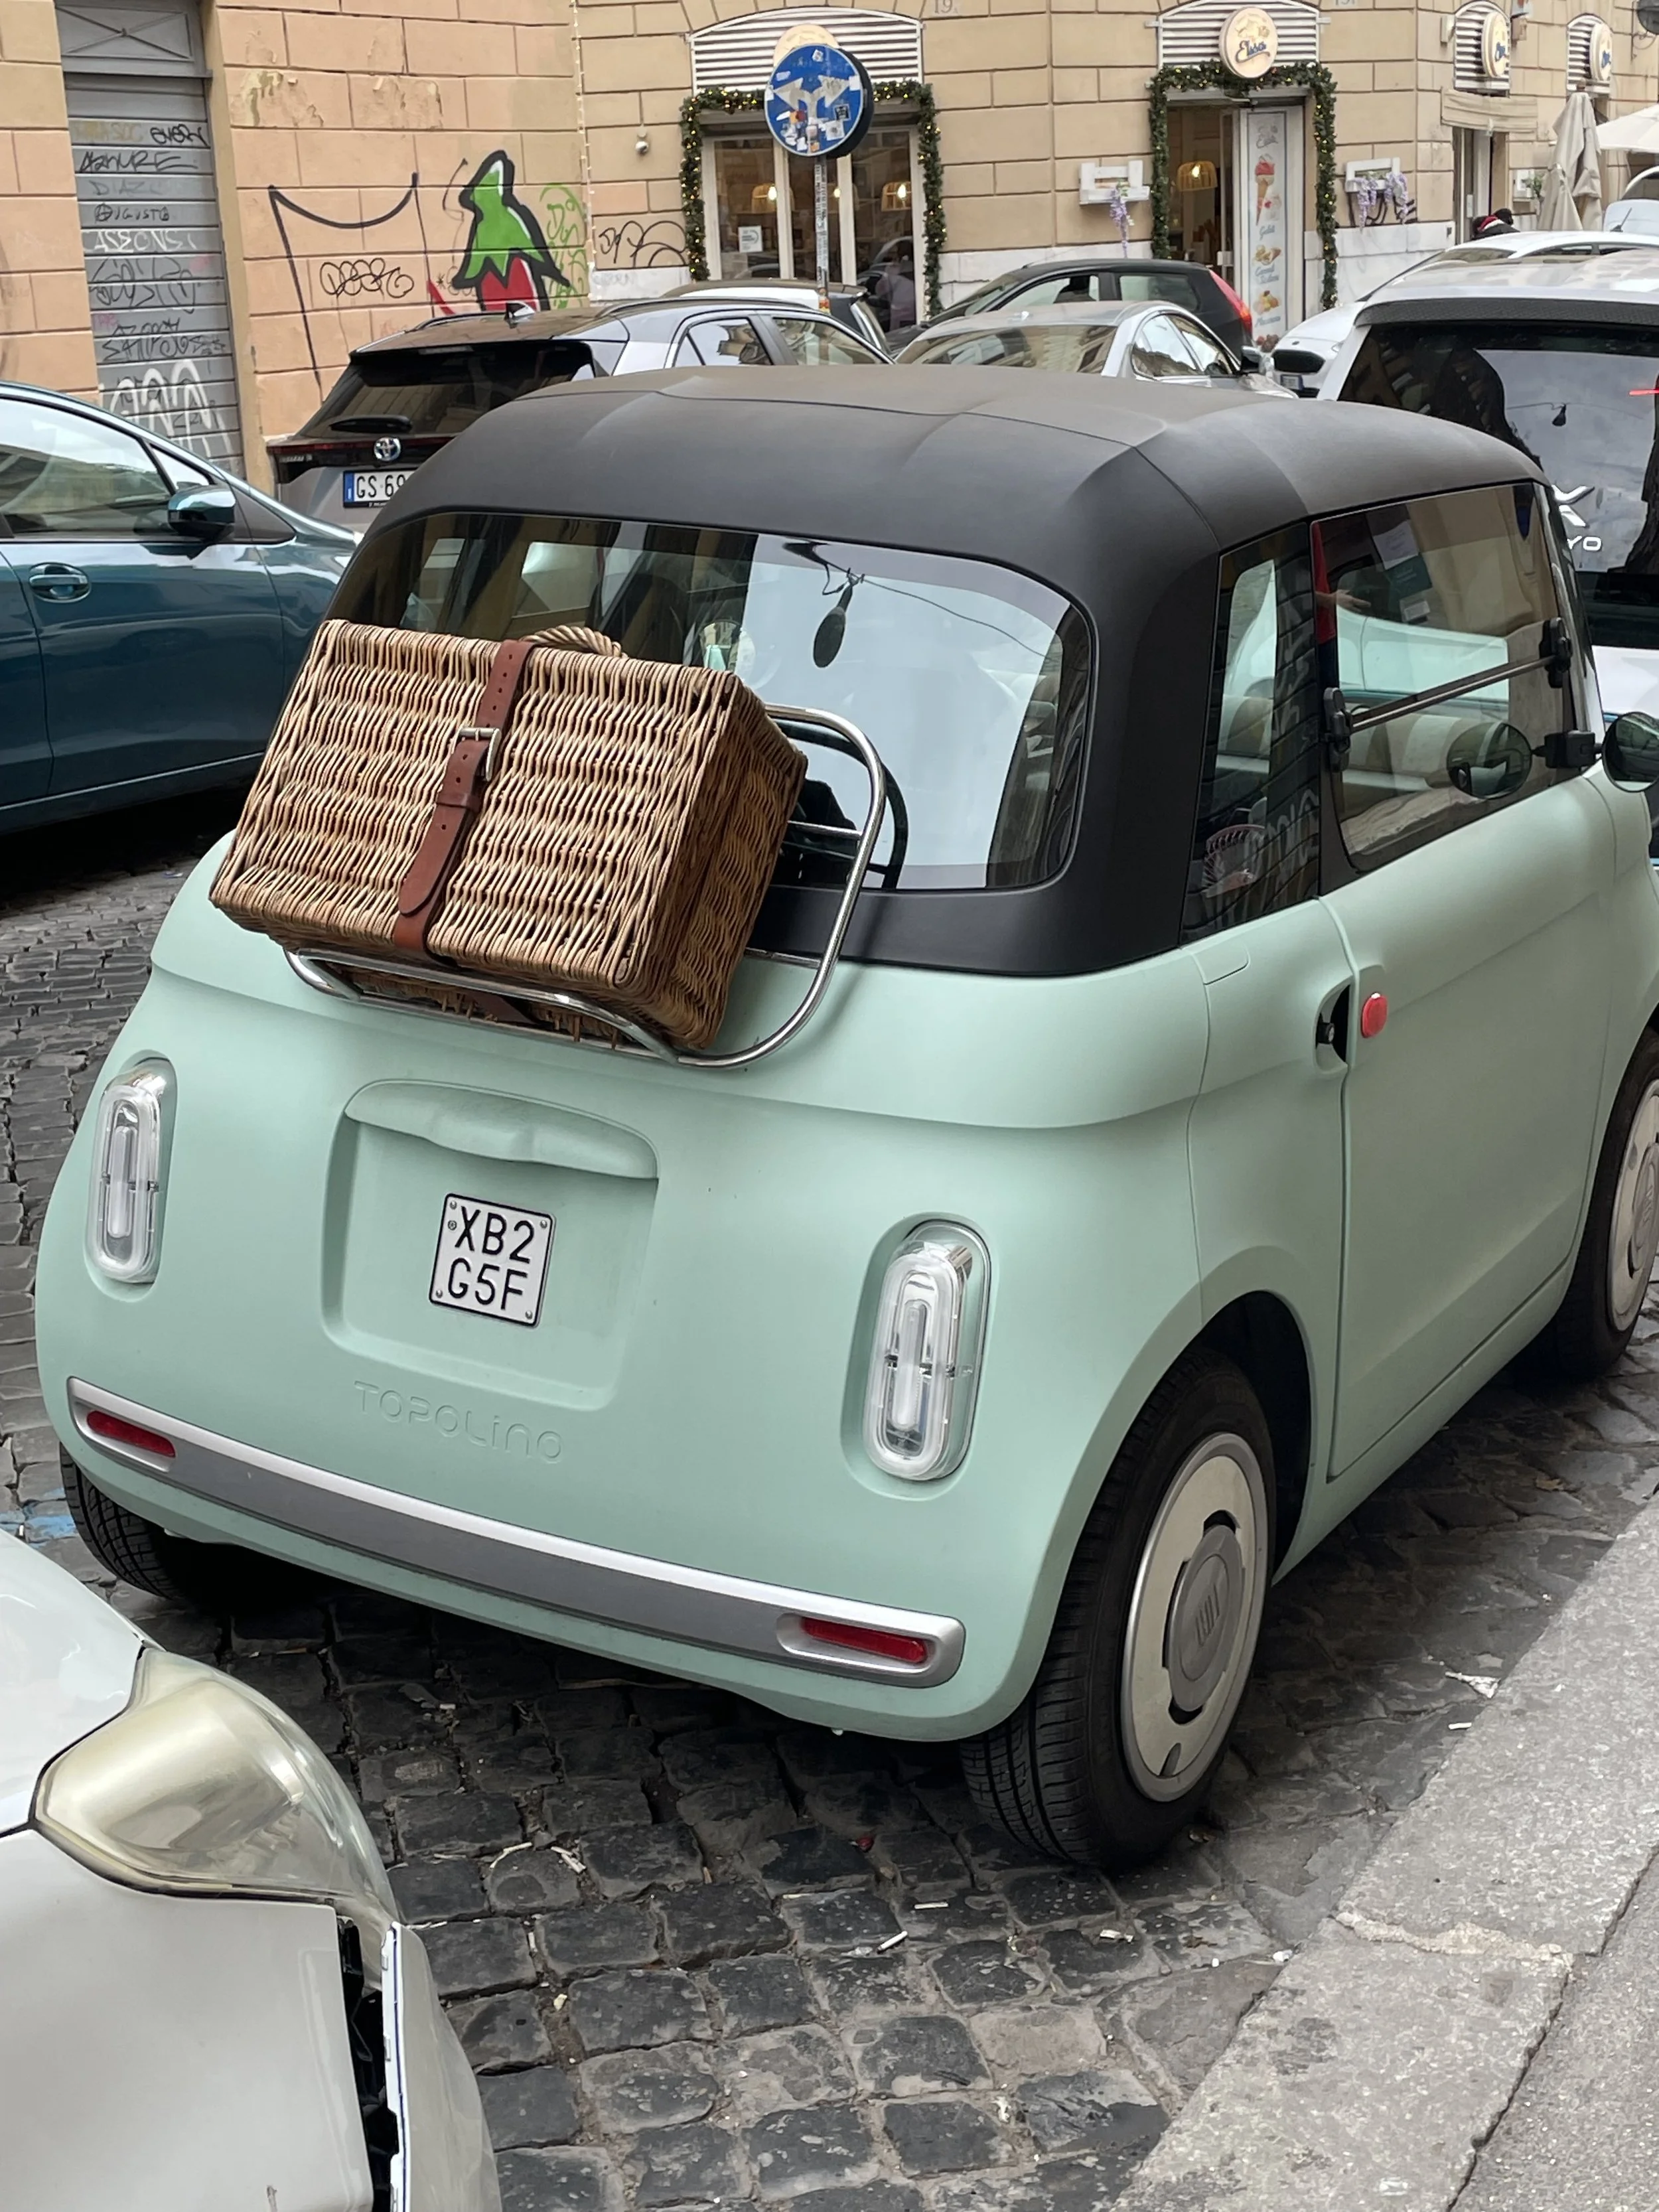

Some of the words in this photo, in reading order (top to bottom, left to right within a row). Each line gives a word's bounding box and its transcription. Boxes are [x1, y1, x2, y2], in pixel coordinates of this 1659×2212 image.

[356, 475, 377, 498] GS
[455, 1205, 535, 1264] XB2
[448, 1257, 528, 1311] G5F
